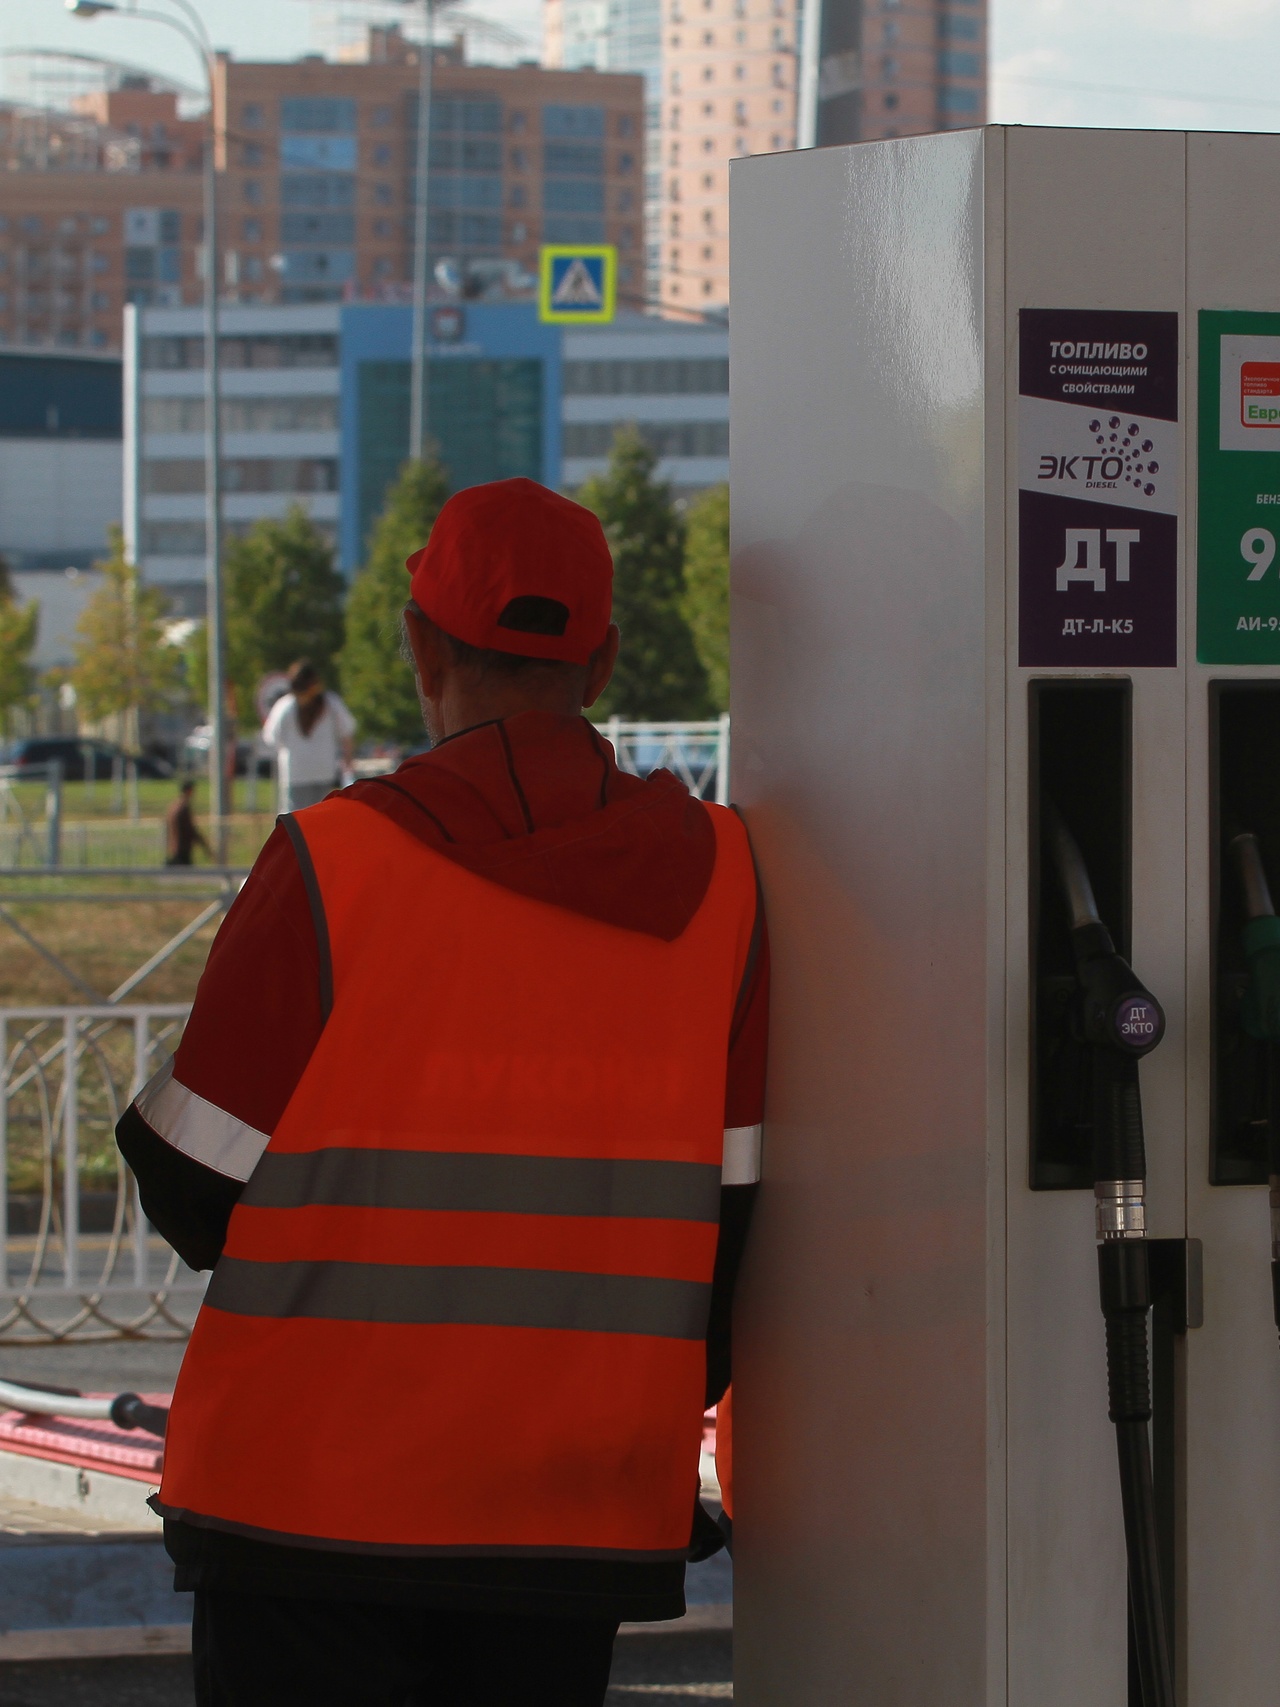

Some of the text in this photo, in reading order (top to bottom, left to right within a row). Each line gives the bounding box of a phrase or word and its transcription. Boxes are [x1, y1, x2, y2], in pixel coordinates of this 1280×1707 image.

[1050, 342, 1148, 359] ТОПЛИВО
[1050, 365, 1148, 377] С ОЧИЩАЮЩИМИ
[1062, 382, 1135, 394] СВОЙСТВАМИ
[1038, 456, 1123, 480] ЭКТО
[1056, 528, 1140, 592] ДТ
[1062, 618, 1134, 636] ДТ-Л-К5
[1130, 1007, 1147, 1021] ДТ
[1121, 1021, 1154, 1034] ЭКТО
